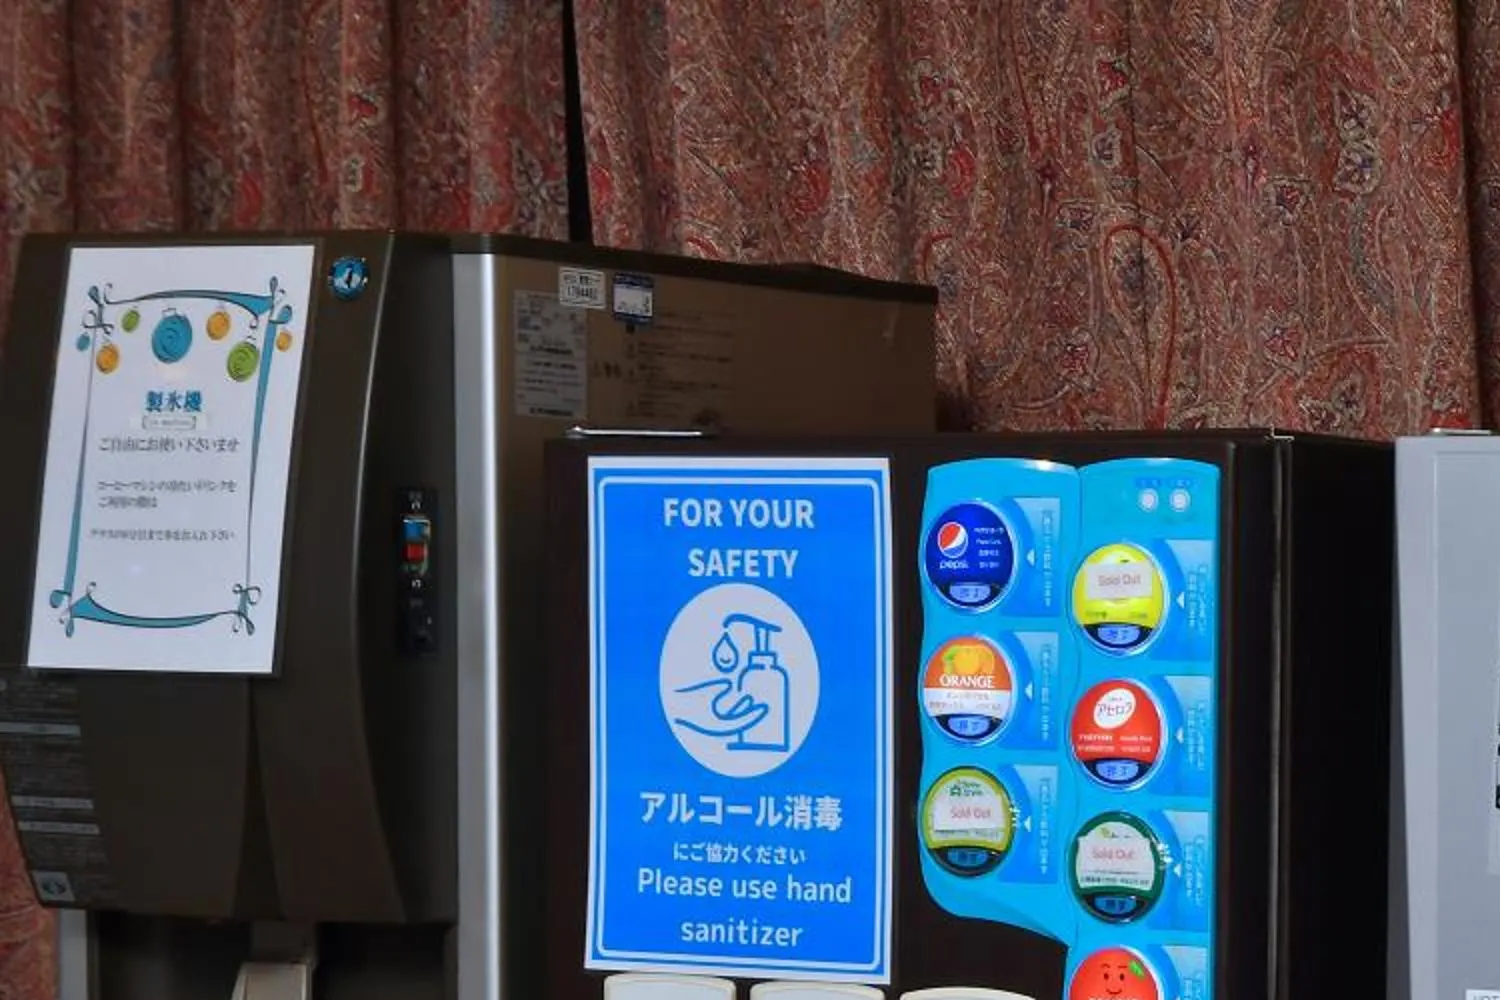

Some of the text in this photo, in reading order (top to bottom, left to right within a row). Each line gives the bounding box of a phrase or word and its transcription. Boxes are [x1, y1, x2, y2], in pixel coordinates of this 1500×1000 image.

[663, 497, 815, 530] FOR YOUR
[687, 548, 799, 579] SAFETY
[939, 674, 997, 689] ORANGE
[638, 791, 844, 832] アルコール消毒
[673, 841, 806, 866] にご協力ください
[638, 867, 853, 904] Please use hand
[681, 918, 803, 948] sanitizer
